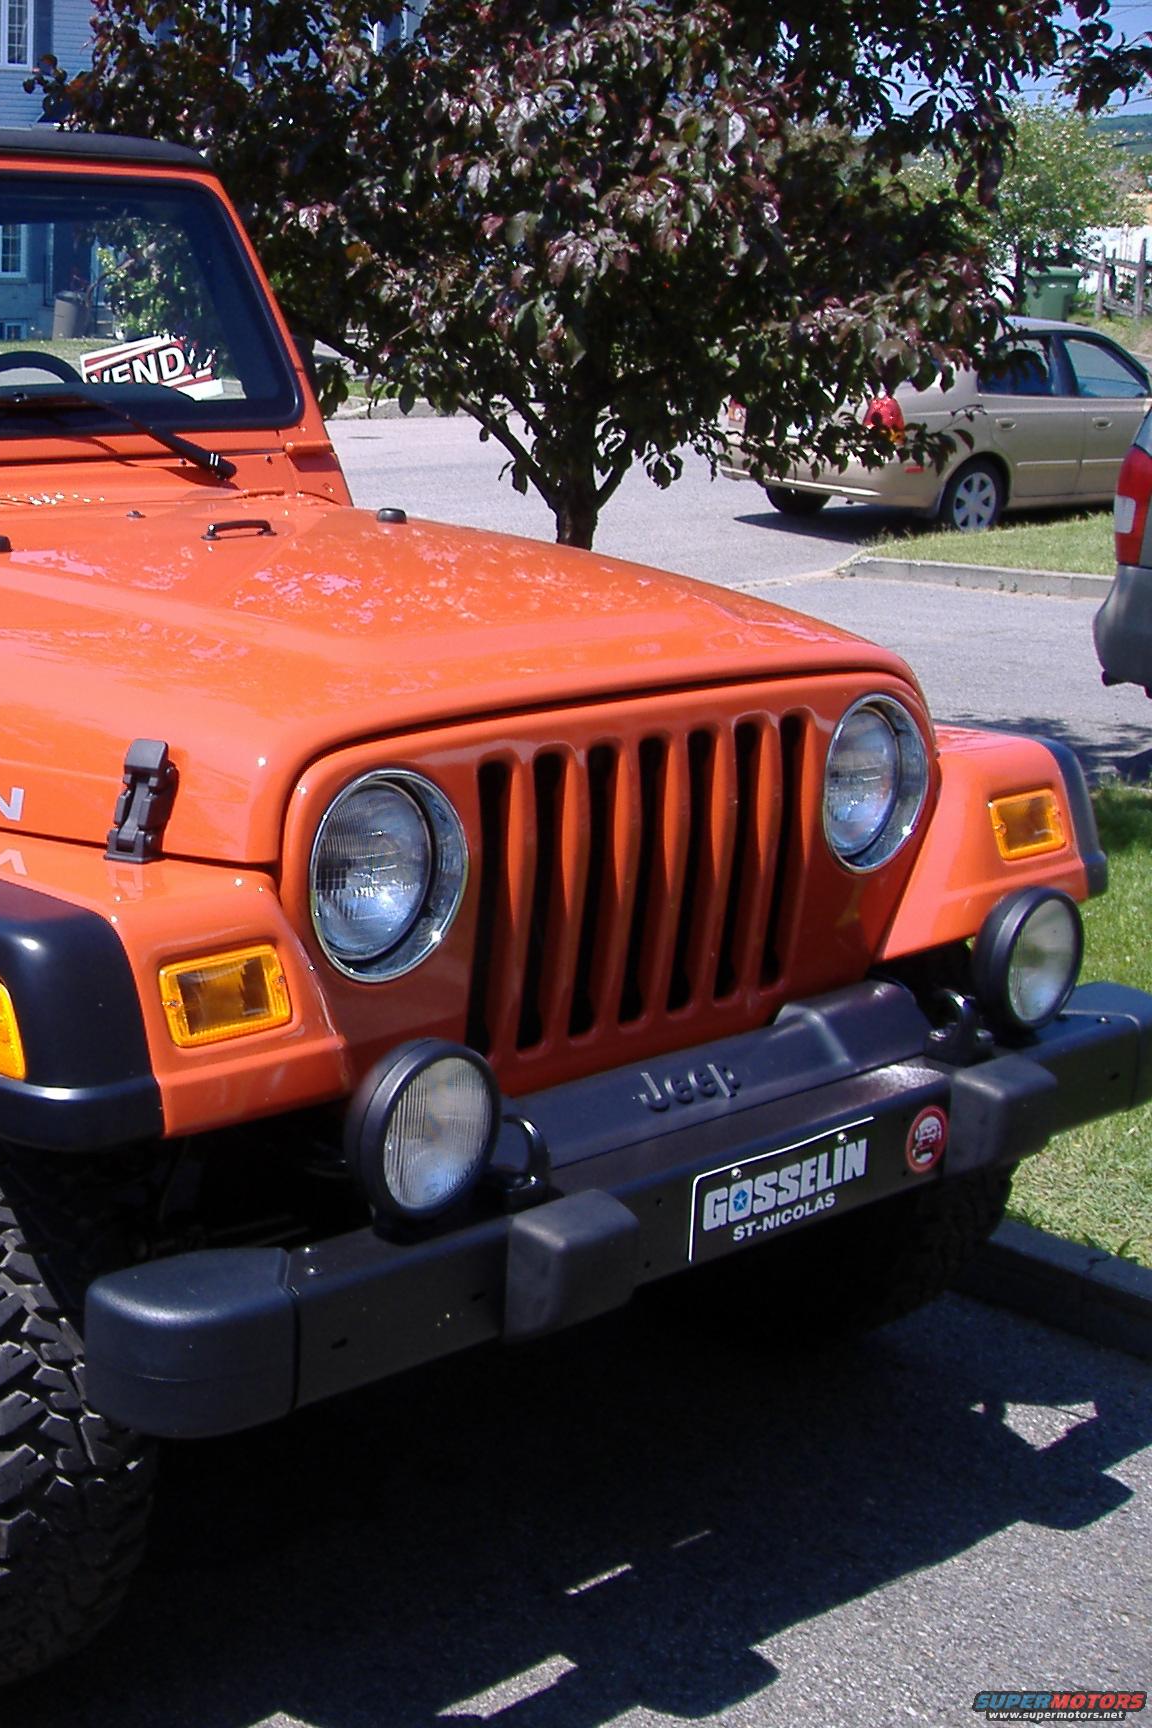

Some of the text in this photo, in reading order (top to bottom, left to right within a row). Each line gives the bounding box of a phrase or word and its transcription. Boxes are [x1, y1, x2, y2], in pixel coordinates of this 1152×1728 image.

[633, 1063, 741, 1112] Jeep
[703, 1138, 867, 1231] GOSSELIN
[733, 1192, 835, 1241] ST-NICOLAS
